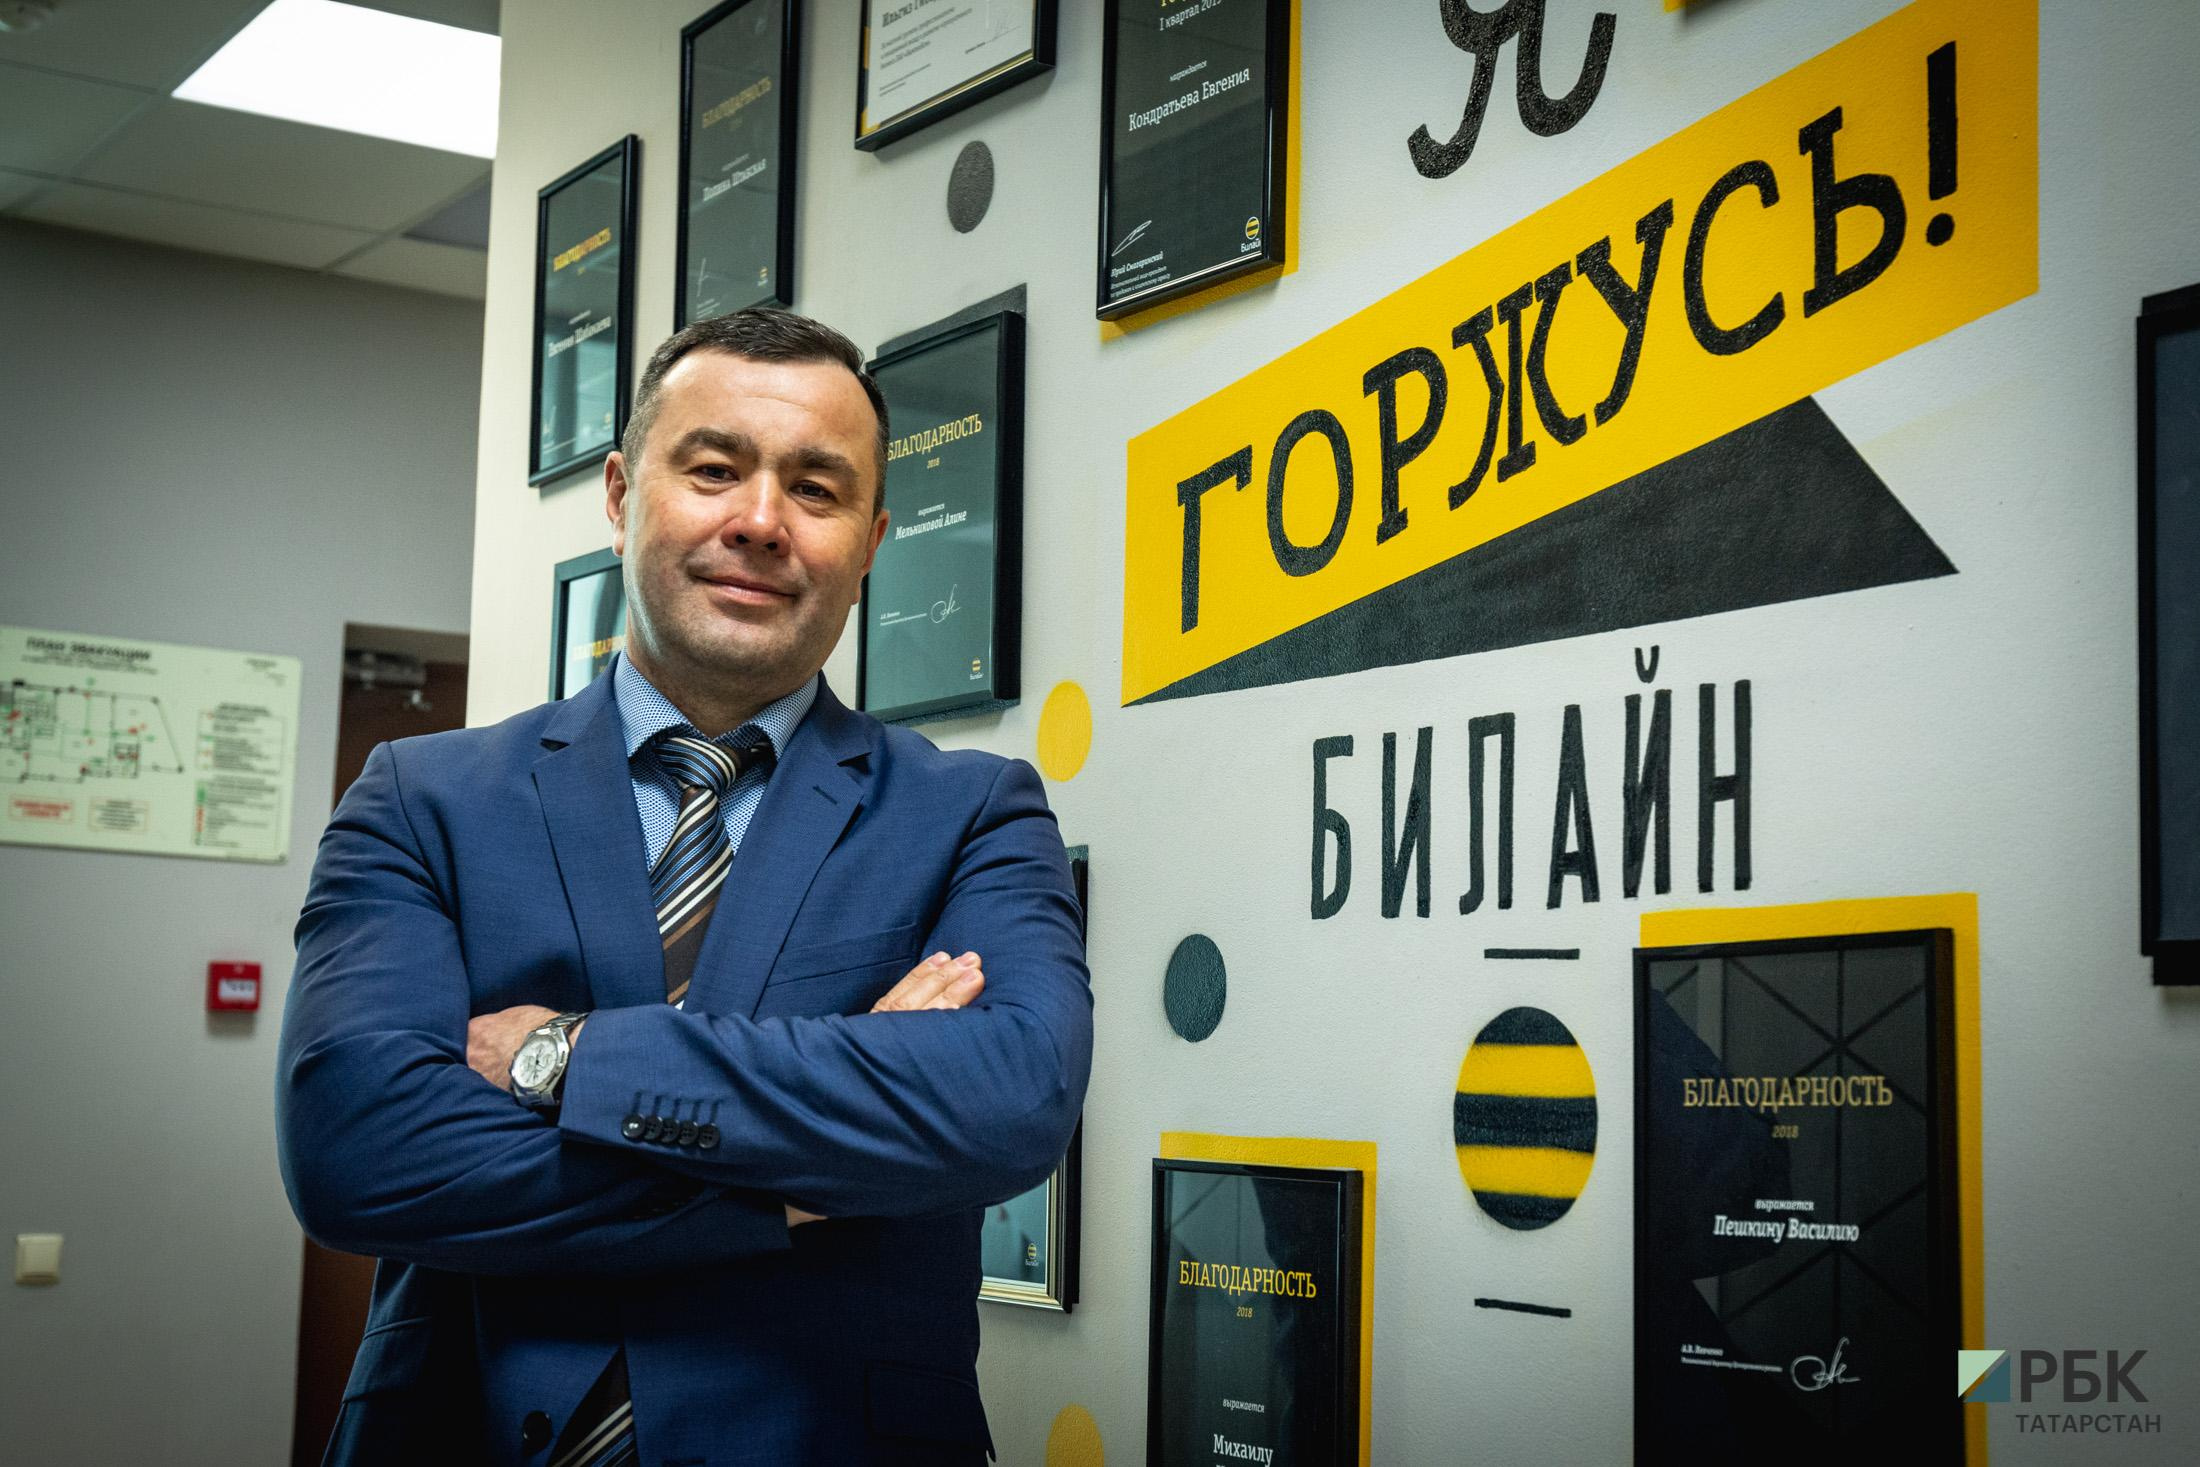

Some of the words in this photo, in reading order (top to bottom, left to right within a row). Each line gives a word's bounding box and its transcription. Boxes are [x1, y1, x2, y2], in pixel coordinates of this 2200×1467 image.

[1165, 4, 1200, 28] квартал
[1128, 90, 1200, 131] Кондратьева
[1201, 68, 1250, 100] Евгения
[1407, 0, 1616, 179] Я
[1177, 41, 1957, 634] ГОРЖУСЬ!
[888, 413, 983, 462] БЛАГОДАРНОСТЬ
[895, 514, 944, 540] Мельниковой
[944, 510, 967, 525] Алине
[1311, 645, 1752, 920] БИЛАЙН
[1682, 1075, 1893, 1114] БЛАГОДАРНОСТЬ
[1772, 1125, 1799, 1138] 2018
[1755, 1199, 1814, 1213] выражается
[1713, 1215, 1786, 1243] Пешкину
[1787, 1217, 1860, 1242] Василию
[1179, 1260, 1317, 1299] БЛАГОДАРНОСТЬ
[1236, 1306, 1253, 1318] 2018
[1223, 1398, 1265, 1414] выражается
[1213, 1433, 1274, 1467] Михаилу
